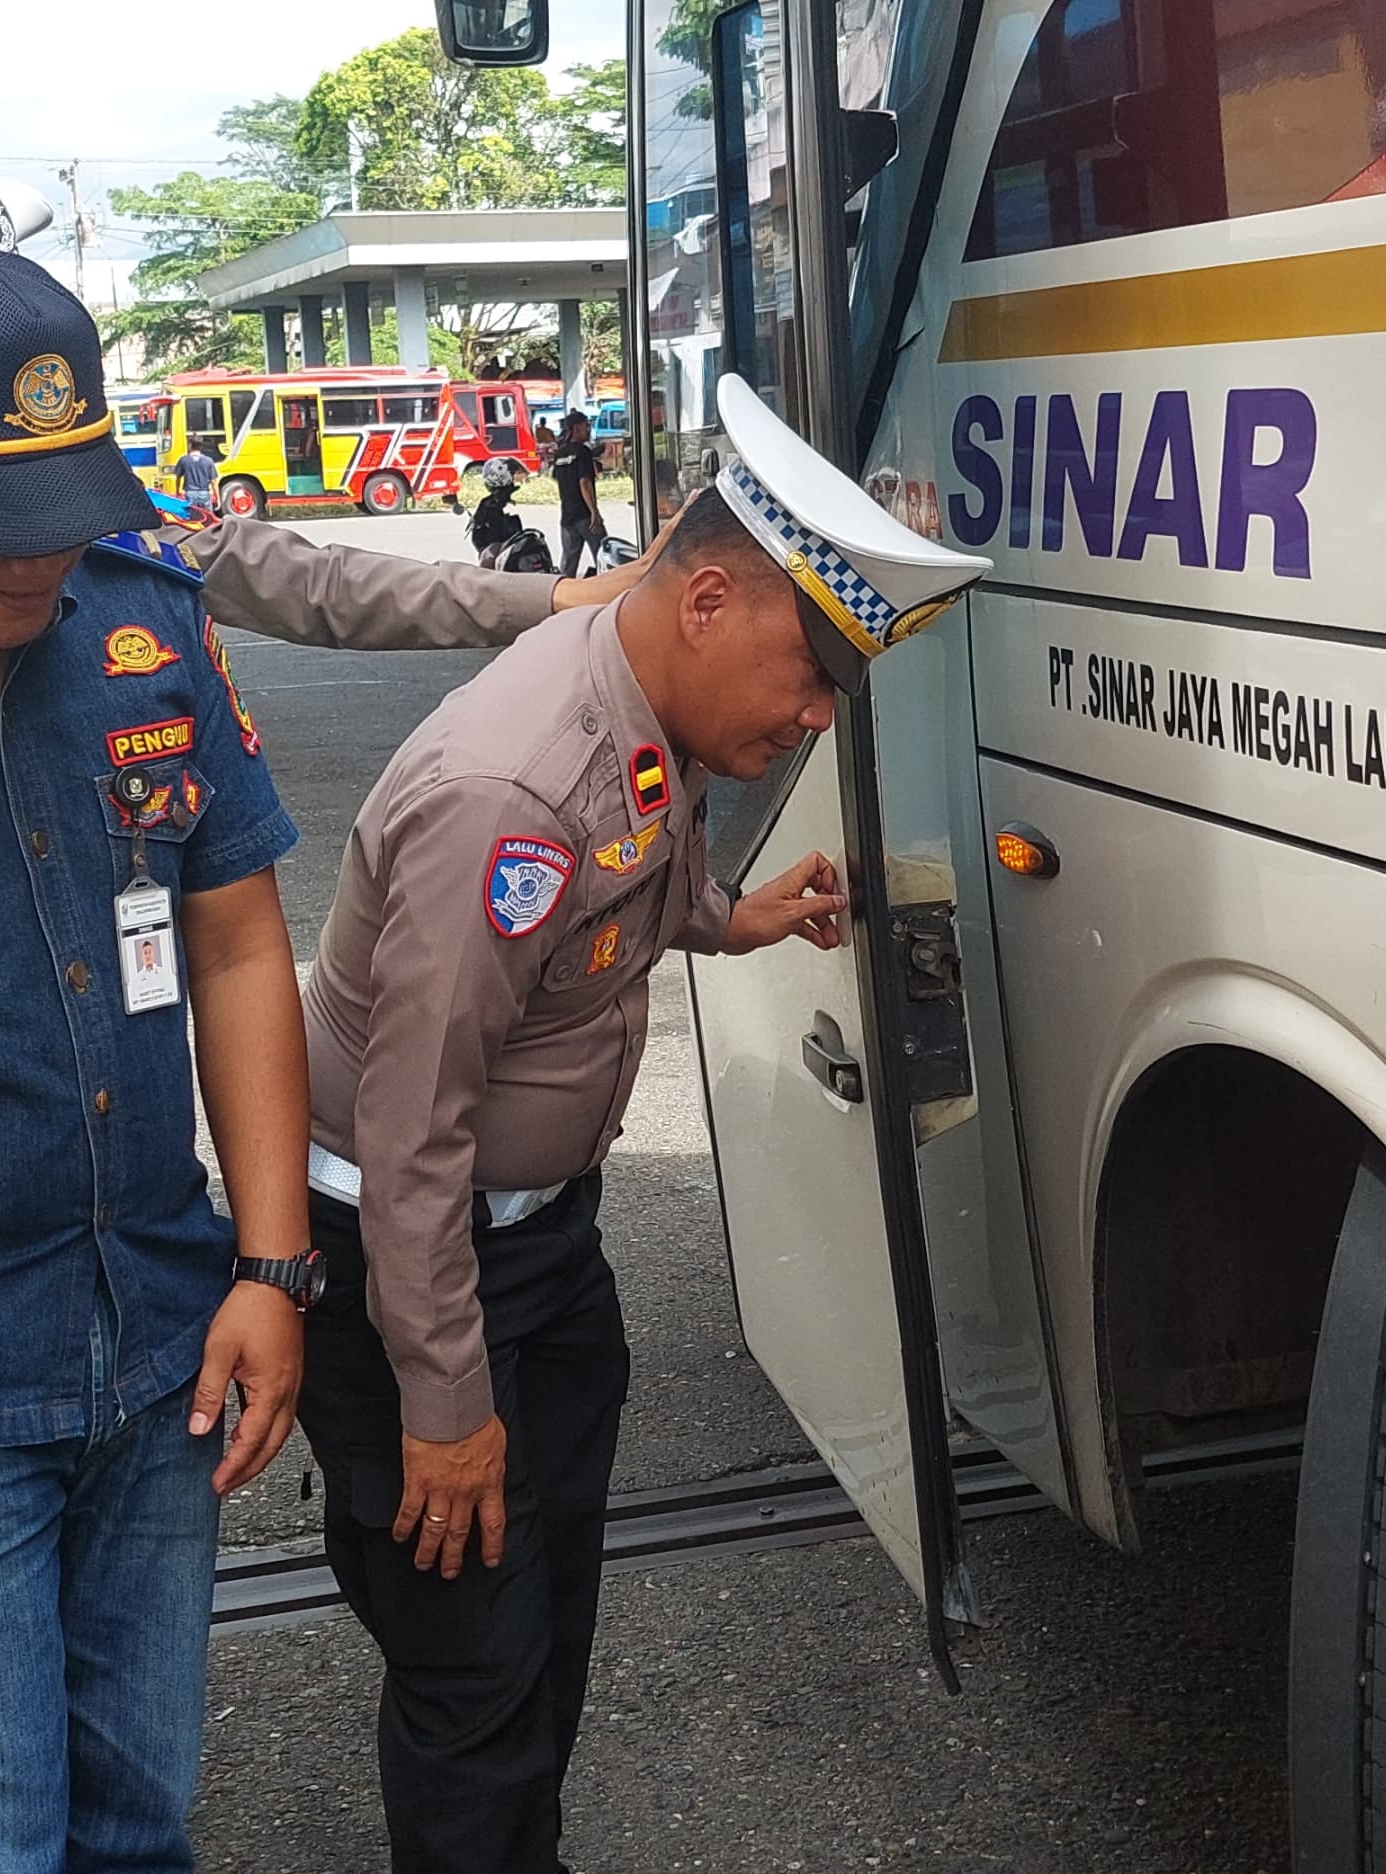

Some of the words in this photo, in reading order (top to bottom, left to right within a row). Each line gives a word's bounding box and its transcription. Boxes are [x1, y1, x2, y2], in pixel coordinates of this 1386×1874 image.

[948, 386, 1318, 580] SINAR
[1048, 645, 1074, 711] PT
[1163, 669, 1226, 750] JAYA
[1231, 681, 1335, 777] MEGAH
[506, 841, 535, 854] LALU
[537, 844, 571, 869] LINTAS
